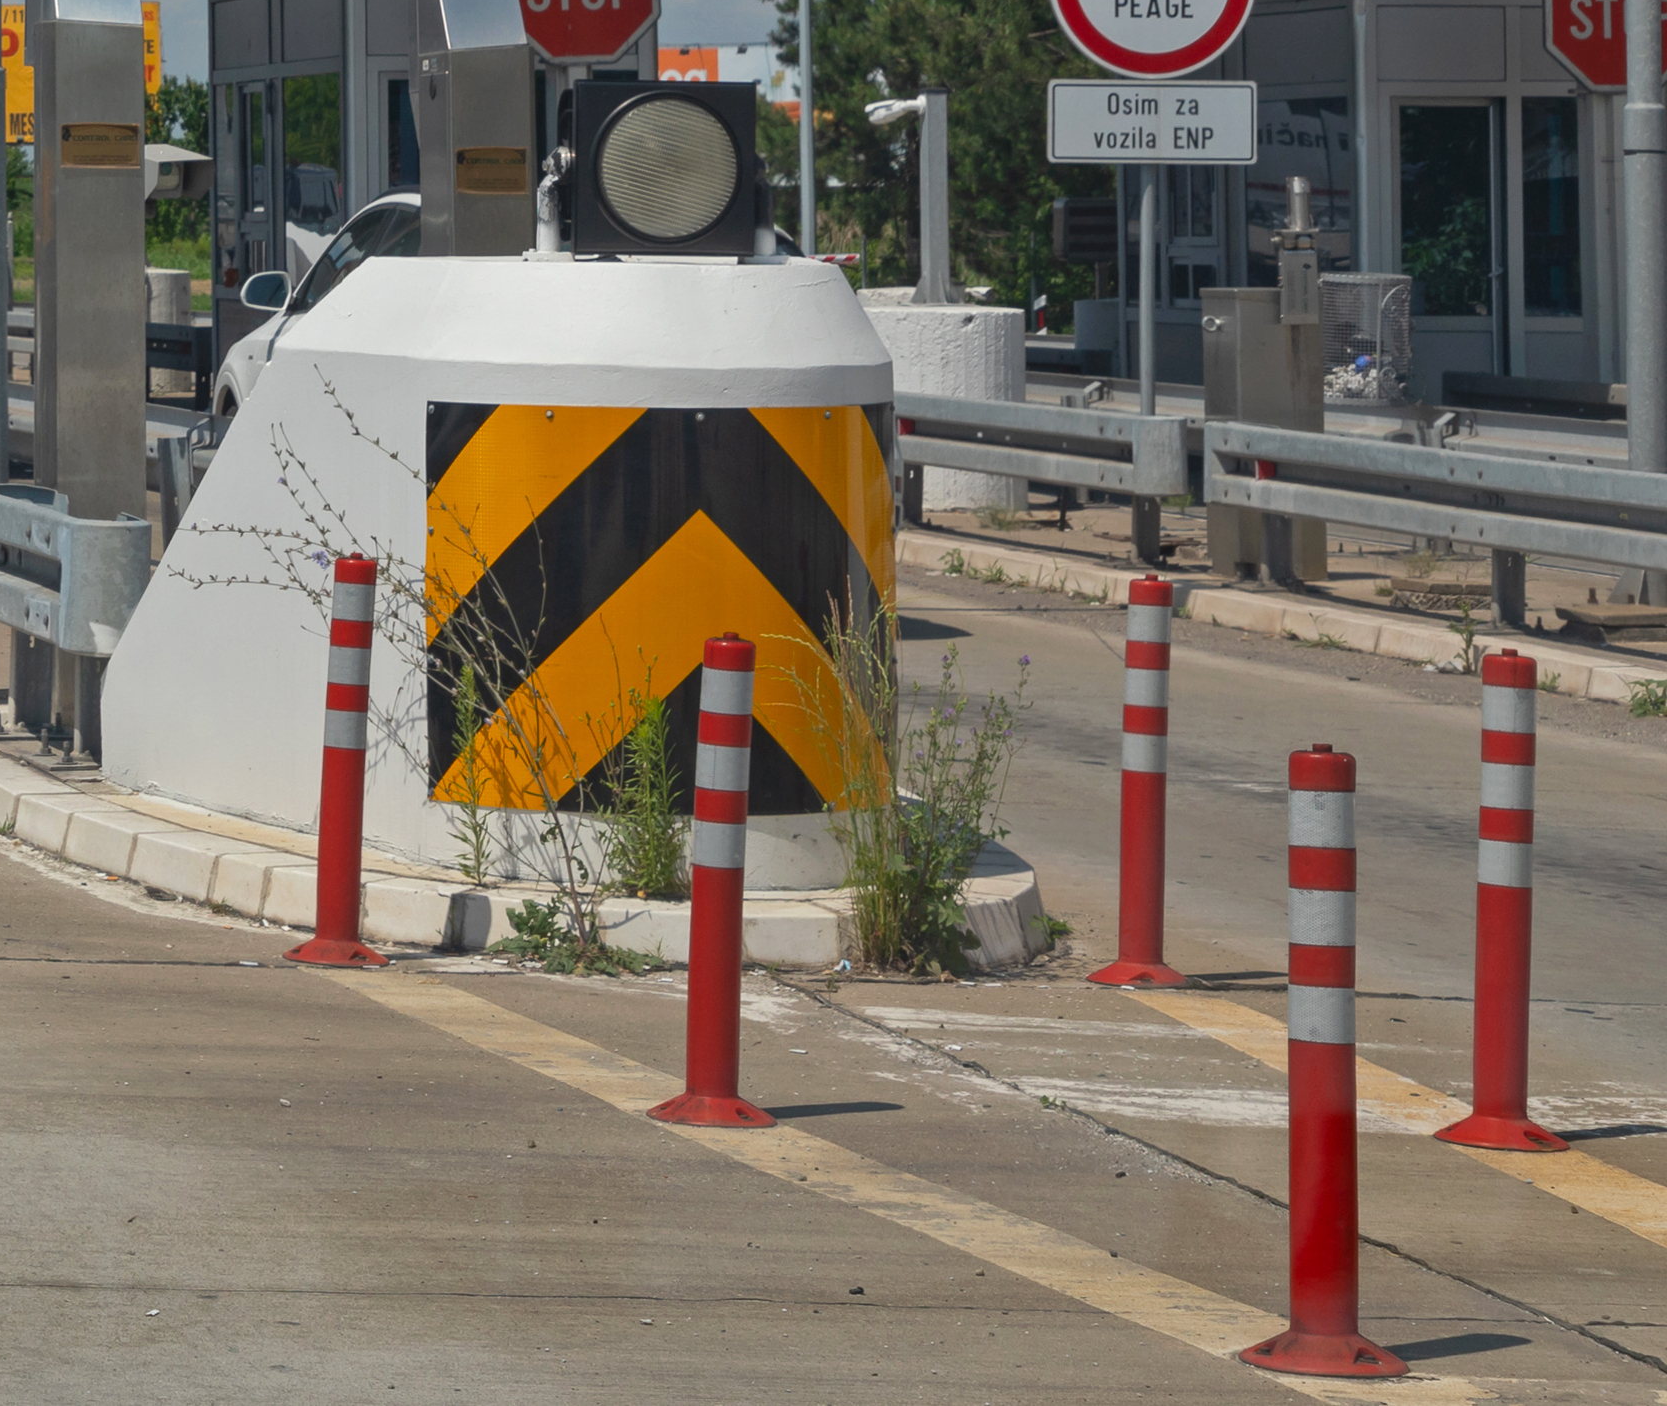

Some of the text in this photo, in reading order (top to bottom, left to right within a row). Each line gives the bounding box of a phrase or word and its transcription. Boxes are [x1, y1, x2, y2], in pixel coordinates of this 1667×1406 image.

[1107, 92, 1199, 115] Osim za
[1094, 126, 1214, 150] vozila ENP
